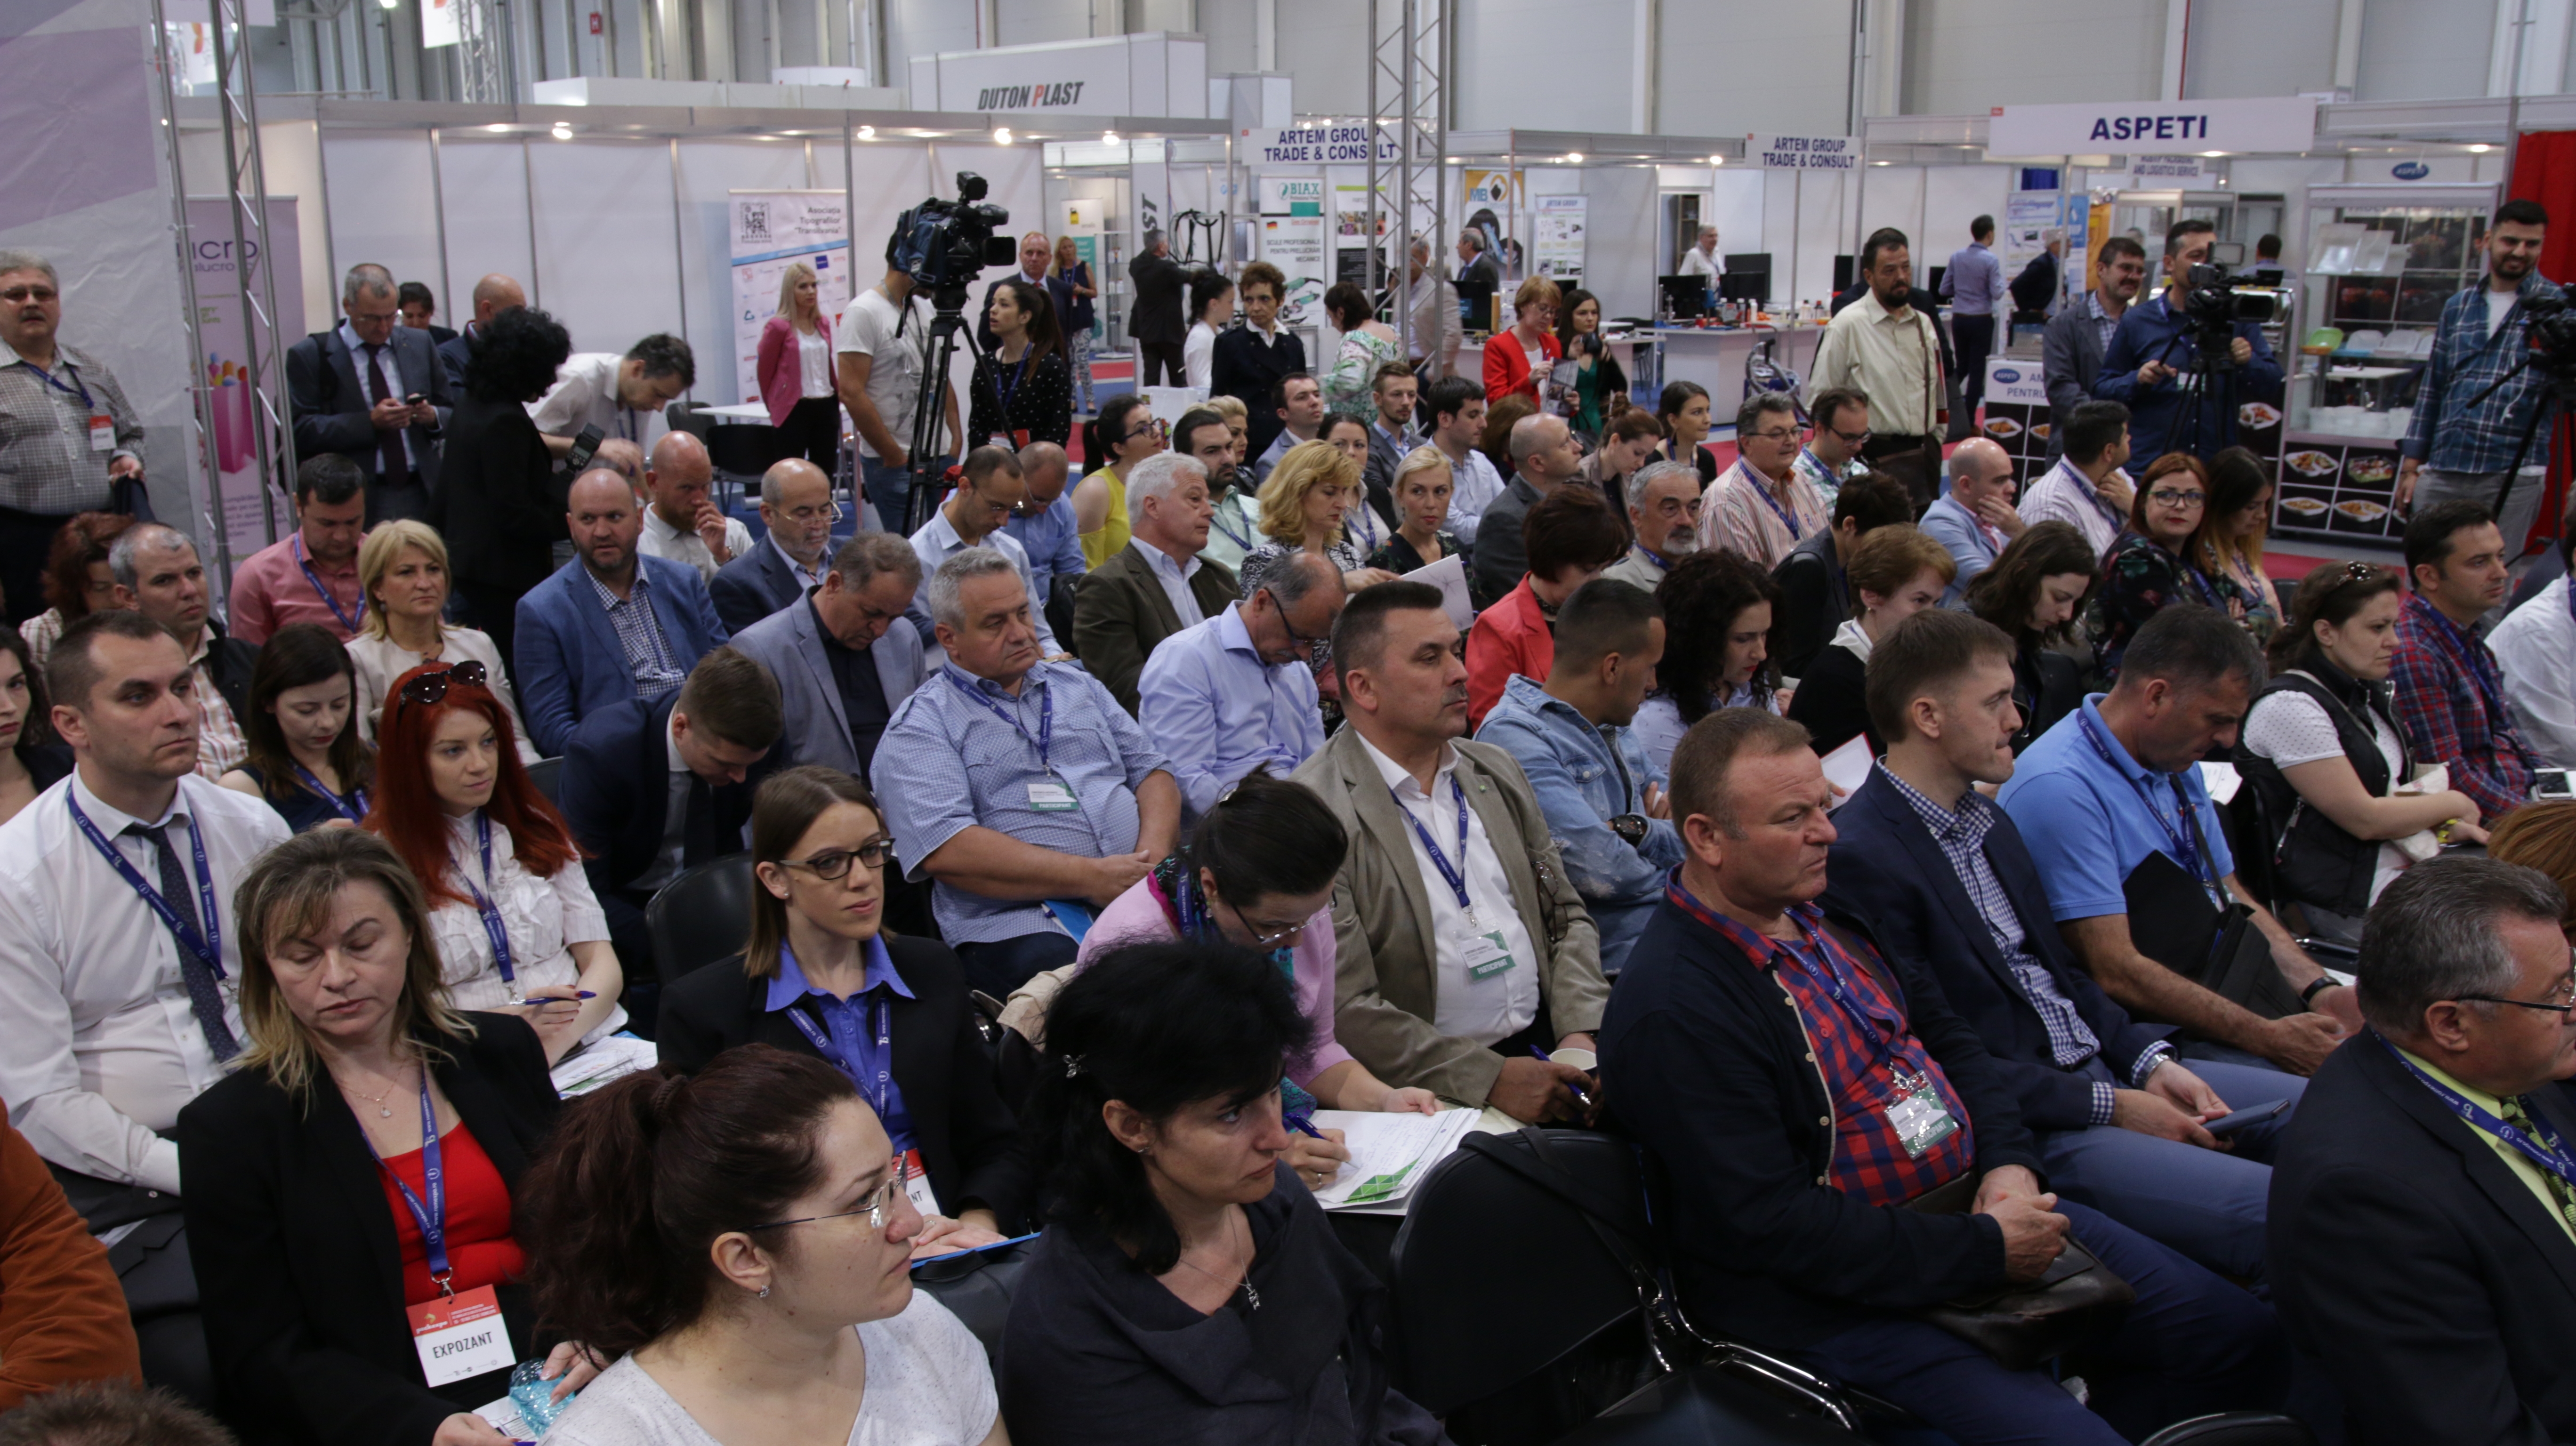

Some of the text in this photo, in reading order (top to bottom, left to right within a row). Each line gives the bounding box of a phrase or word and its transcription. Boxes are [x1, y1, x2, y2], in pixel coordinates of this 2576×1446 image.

[977, 81, 1085, 110] DUTON PLAST
[1279, 129, 1325, 145] ARTEM
[2089, 115, 2208, 140] ASPETI
[1264, 143, 1396, 161] TRADE & CONSLT
[1773, 137, 1846, 153] ARTEM GROUP
[1762, 153, 1855, 169] TRADE & CONSULT
[1290, 183, 1320, 194] BIAX
[1470, 188, 1488, 201] MB
[789, 1006, 817, 1036] www.romexpo.ro
[1841, 999, 1868, 1030] www.romexpo.ro
[421, 1093, 432, 1132] www.romexpo.ro
[1914, 1120, 1947, 1147] ARTICIPANT
[2515, 1136, 2554, 1164] www.romexpo.ro
[404, 1191, 432, 1229] www.romexpo.ro
[432, 1331, 493, 1359] EXPOZANT
